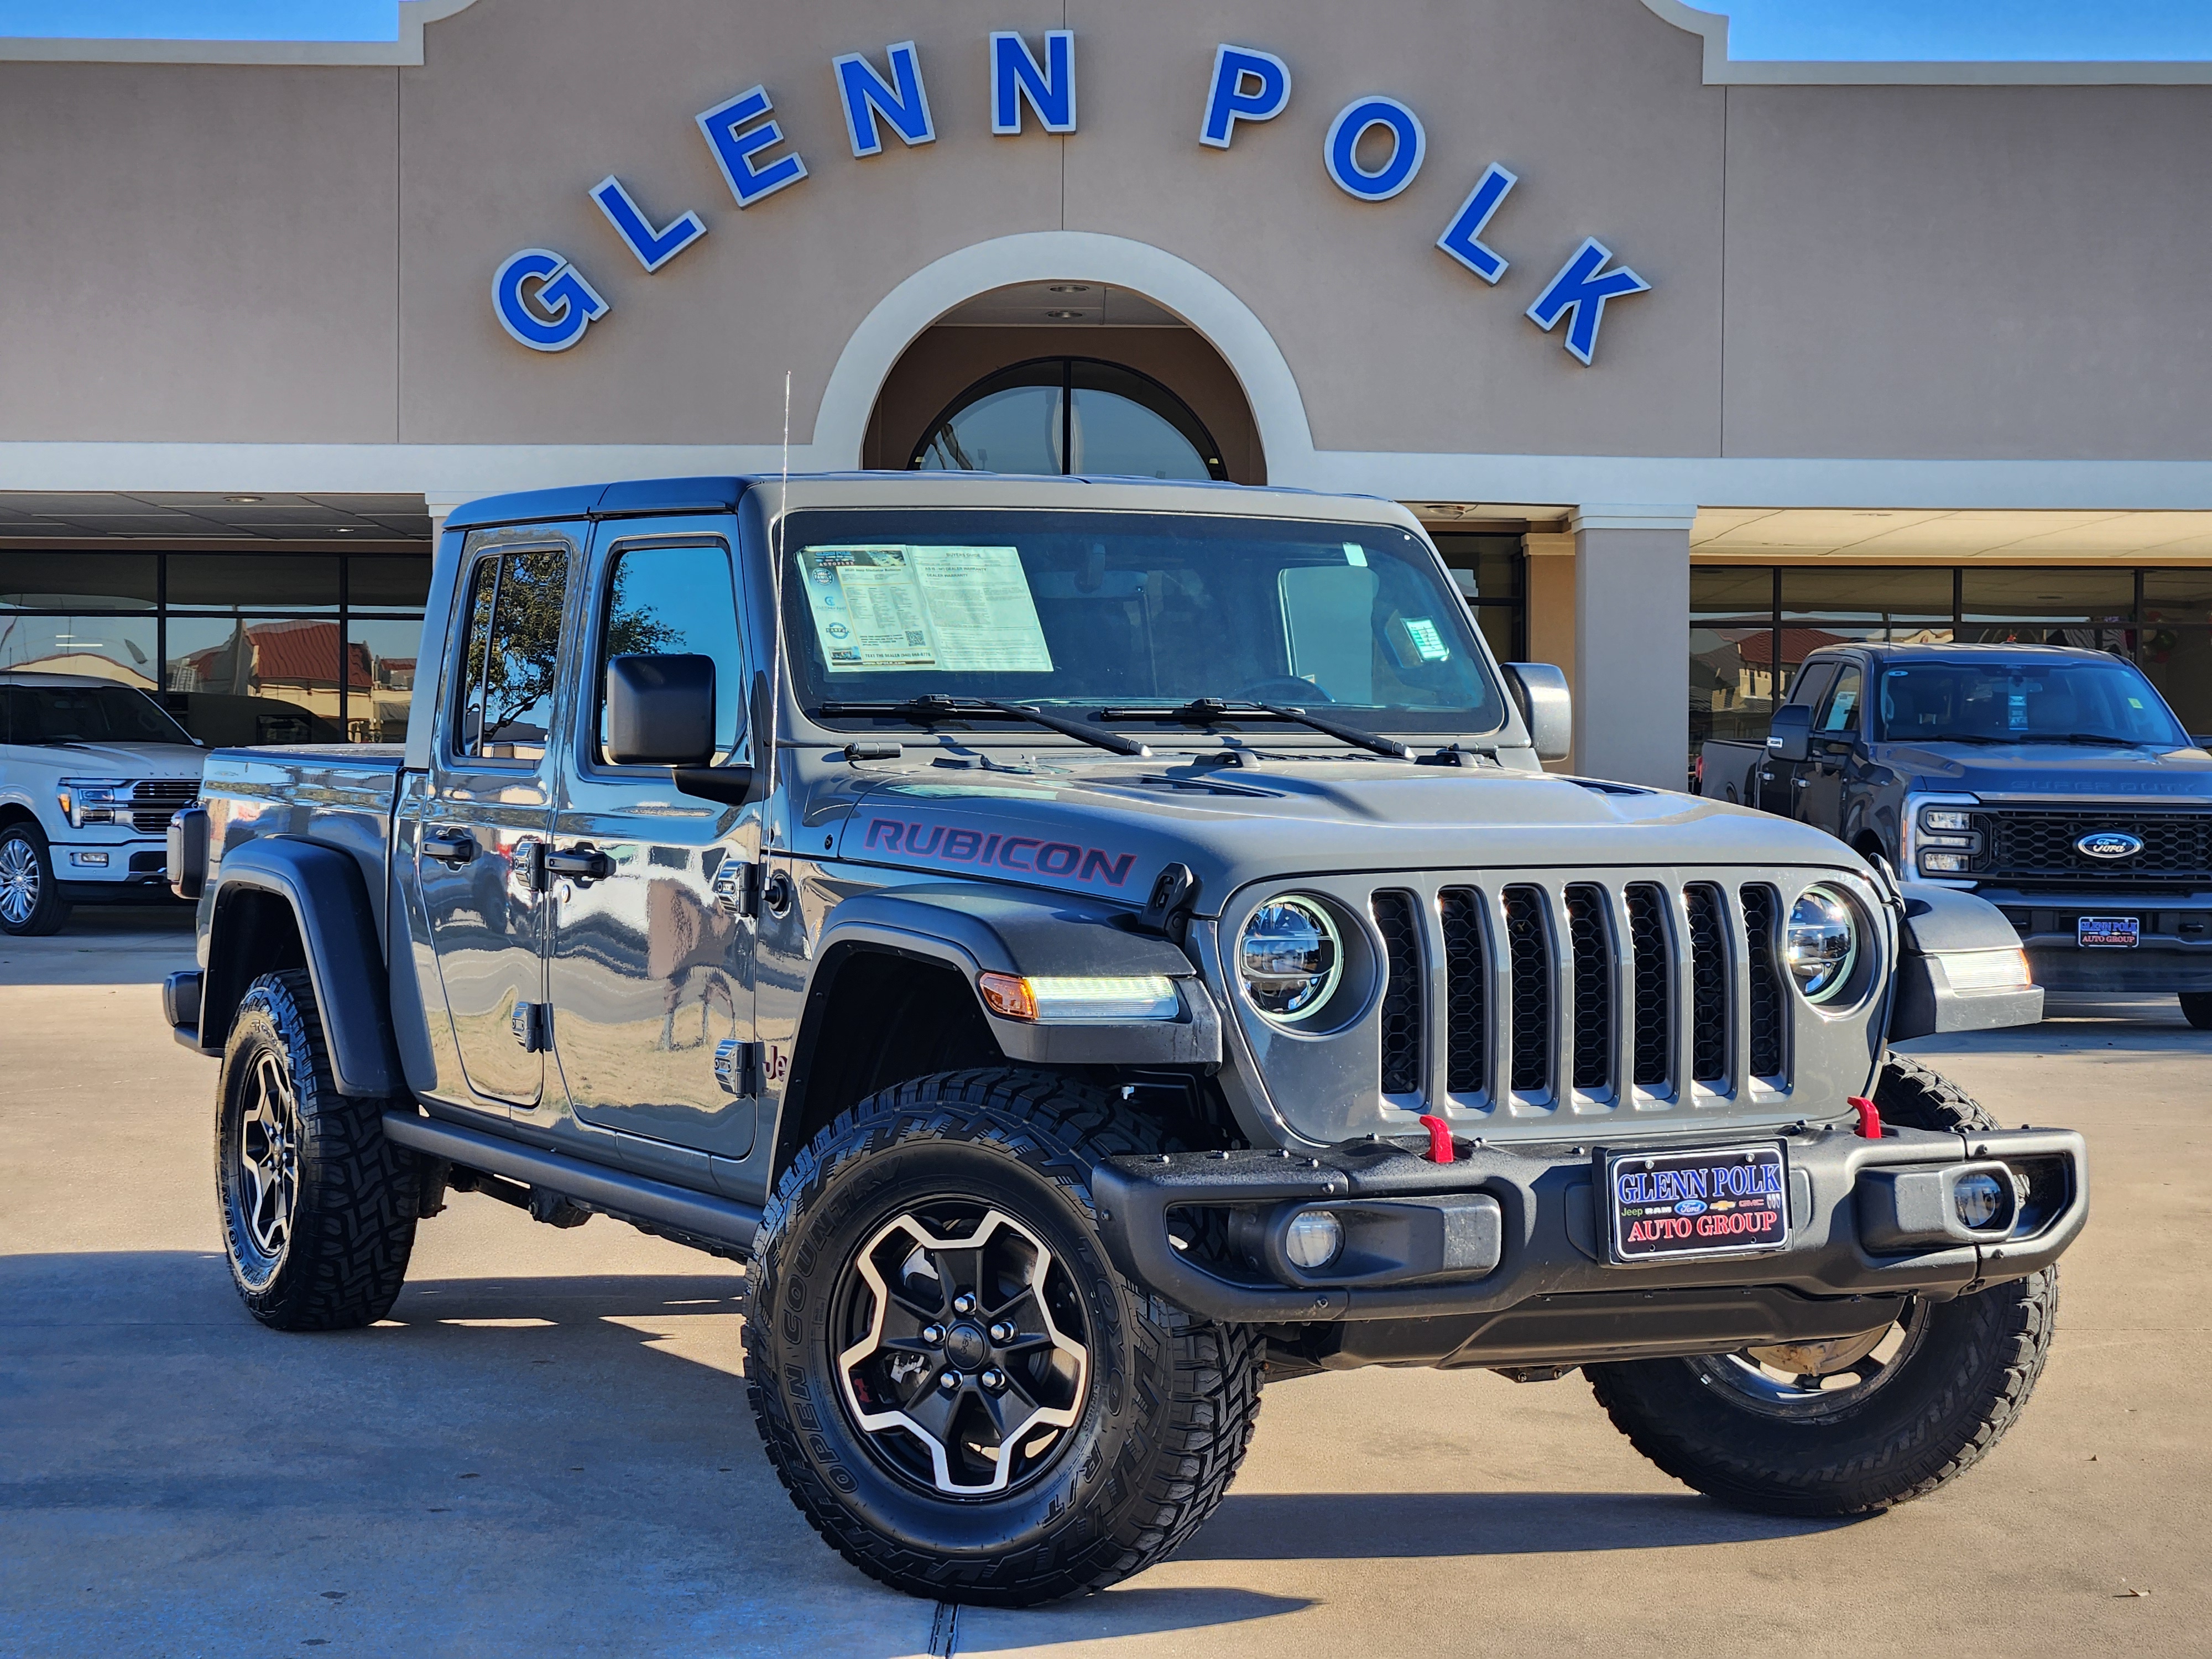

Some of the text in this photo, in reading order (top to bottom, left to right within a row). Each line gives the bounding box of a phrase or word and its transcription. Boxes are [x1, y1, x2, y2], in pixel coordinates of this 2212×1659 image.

[491, 29, 1652, 368] GLENN POLK
[2011, 780, 2110, 792] SUPER
[864, 817, 1138, 887] RUBICON
[2081, 922, 2137, 931] GLENN POLK
[762, 1045, 788, 1082] Je
[1618, 1163, 1782, 1204] GLENN POLK
[1621, 1207, 1643, 1217] Jeep
[1645, 1206, 1672, 1215] RAM
[1627, 1211, 1777, 1242] AUTO GROUP
[782, 1155, 902, 1493] OPEN COUNTRY
[1078, 1237, 1126, 1417] TOYO
[1042, 1439, 1104, 1529] R/T
